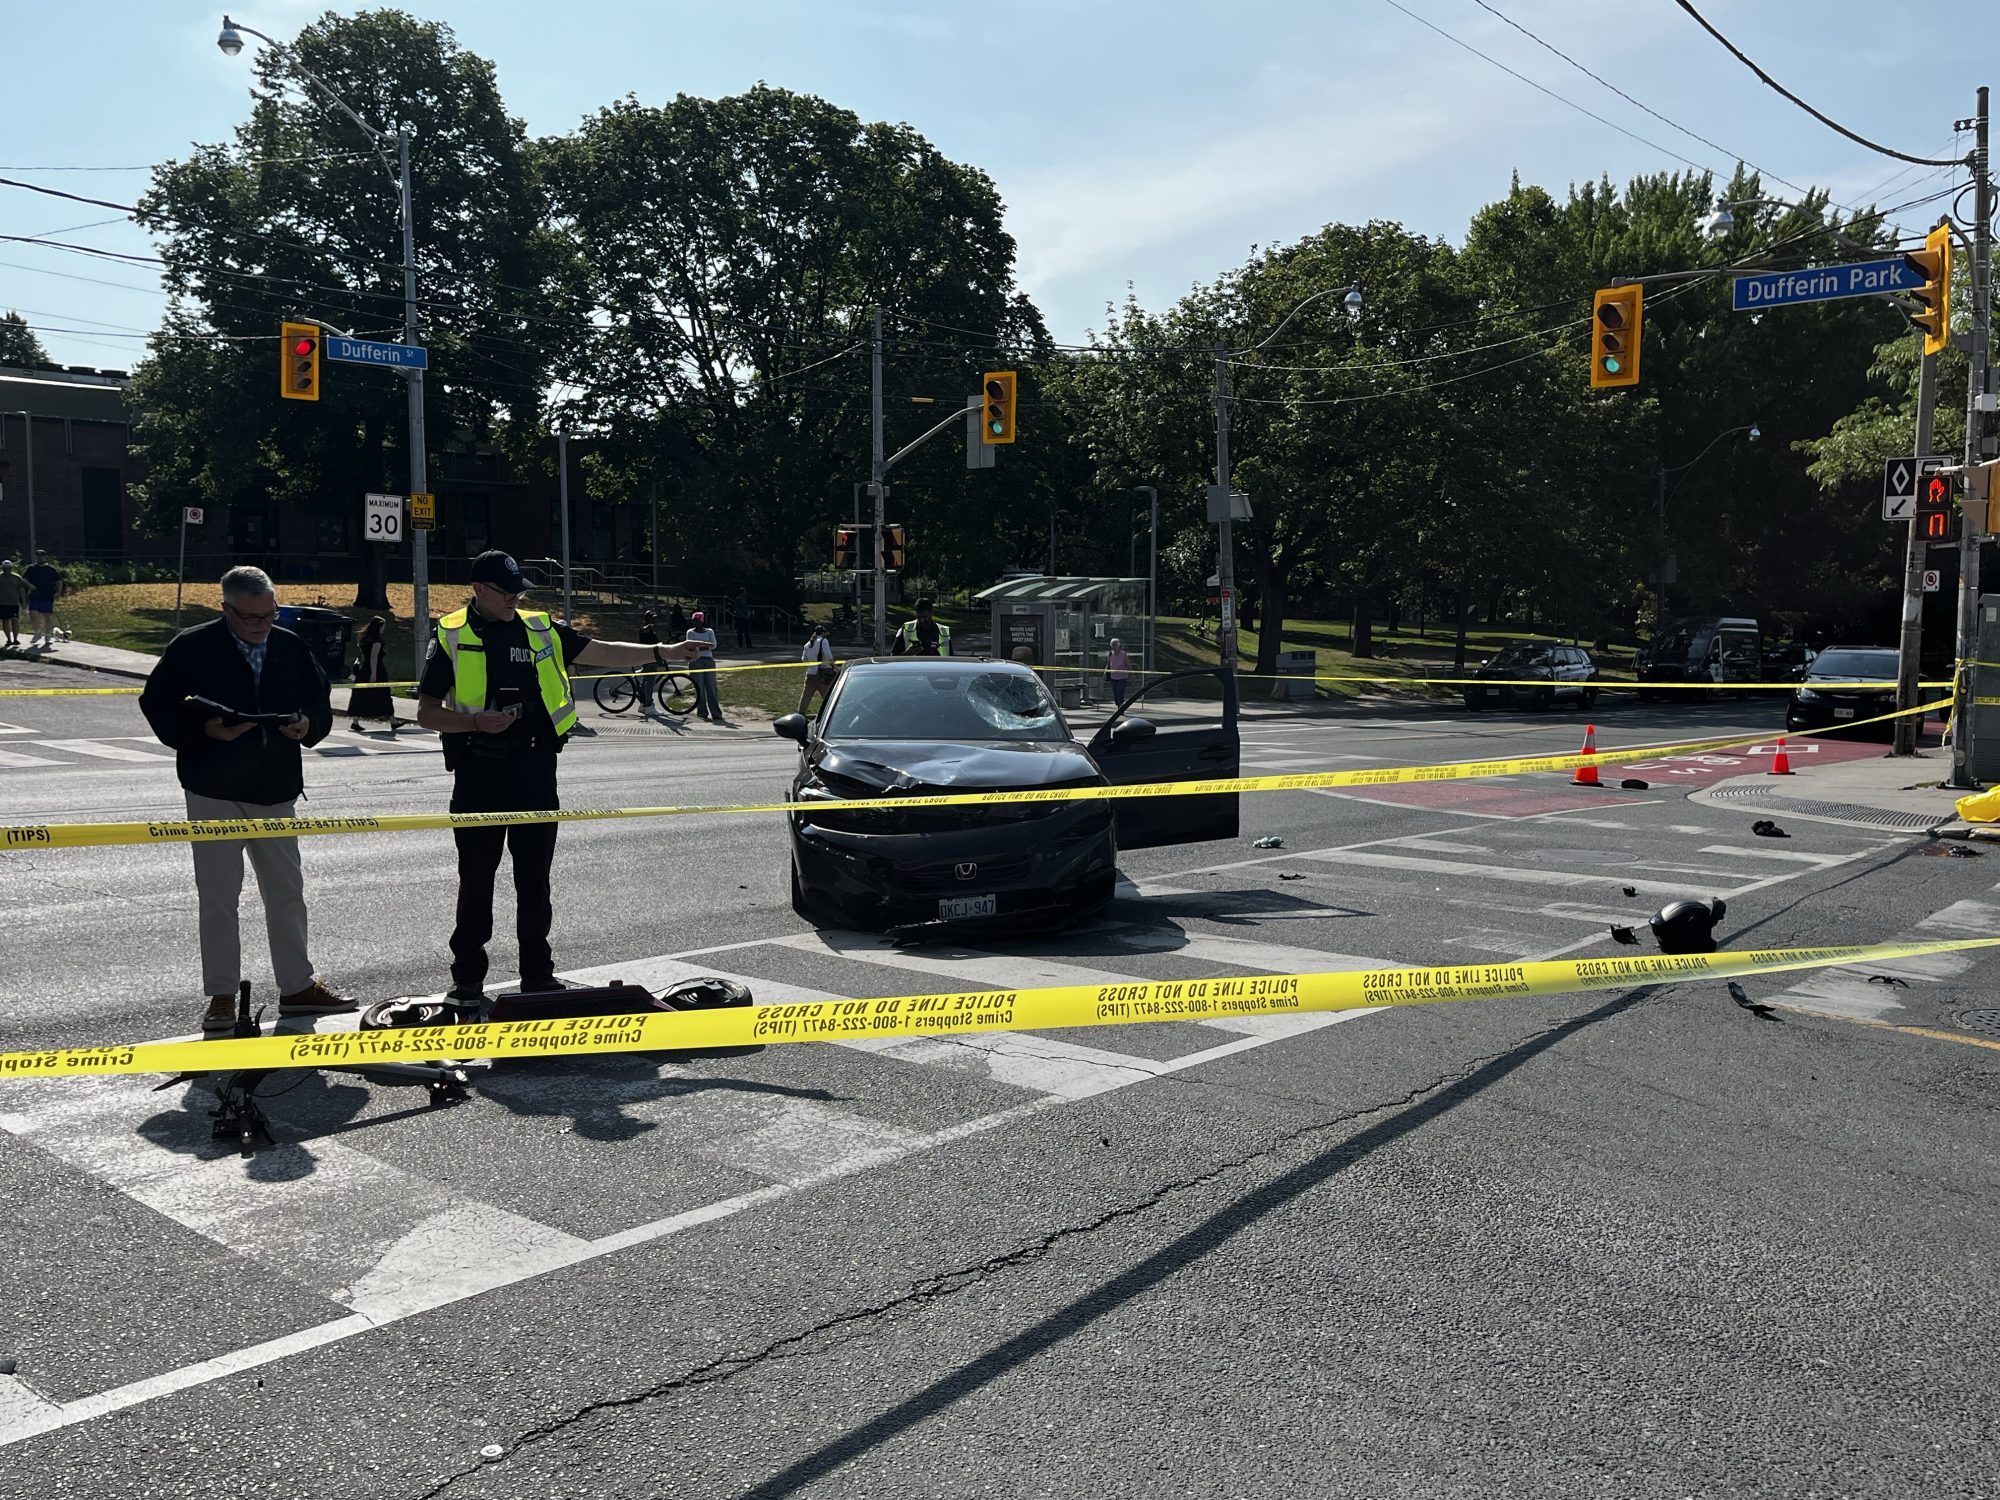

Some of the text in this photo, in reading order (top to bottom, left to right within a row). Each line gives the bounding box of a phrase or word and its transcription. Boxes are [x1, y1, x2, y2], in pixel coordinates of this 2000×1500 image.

[1748, 264, 1903, 302] Dufferin Park
[341, 342, 414, 362] Dufferin St
[369, 499, 399, 509] MAXIMUM
[416, 496, 428, 505] NO
[414, 507, 431, 516] EXIT
[369, 513, 398, 535] 30
[1929, 514, 1945, 536] 17
[510, 647, 531, 662] POLIC
[149, 827, 189, 837] Crime
[192, 825, 248, 836] Stoppers
[252, 820, 342, 832] 1-800-222-8477
[345, 818, 379, 829] (TIPS)
[7, 829, 50, 844] (TIPS)
